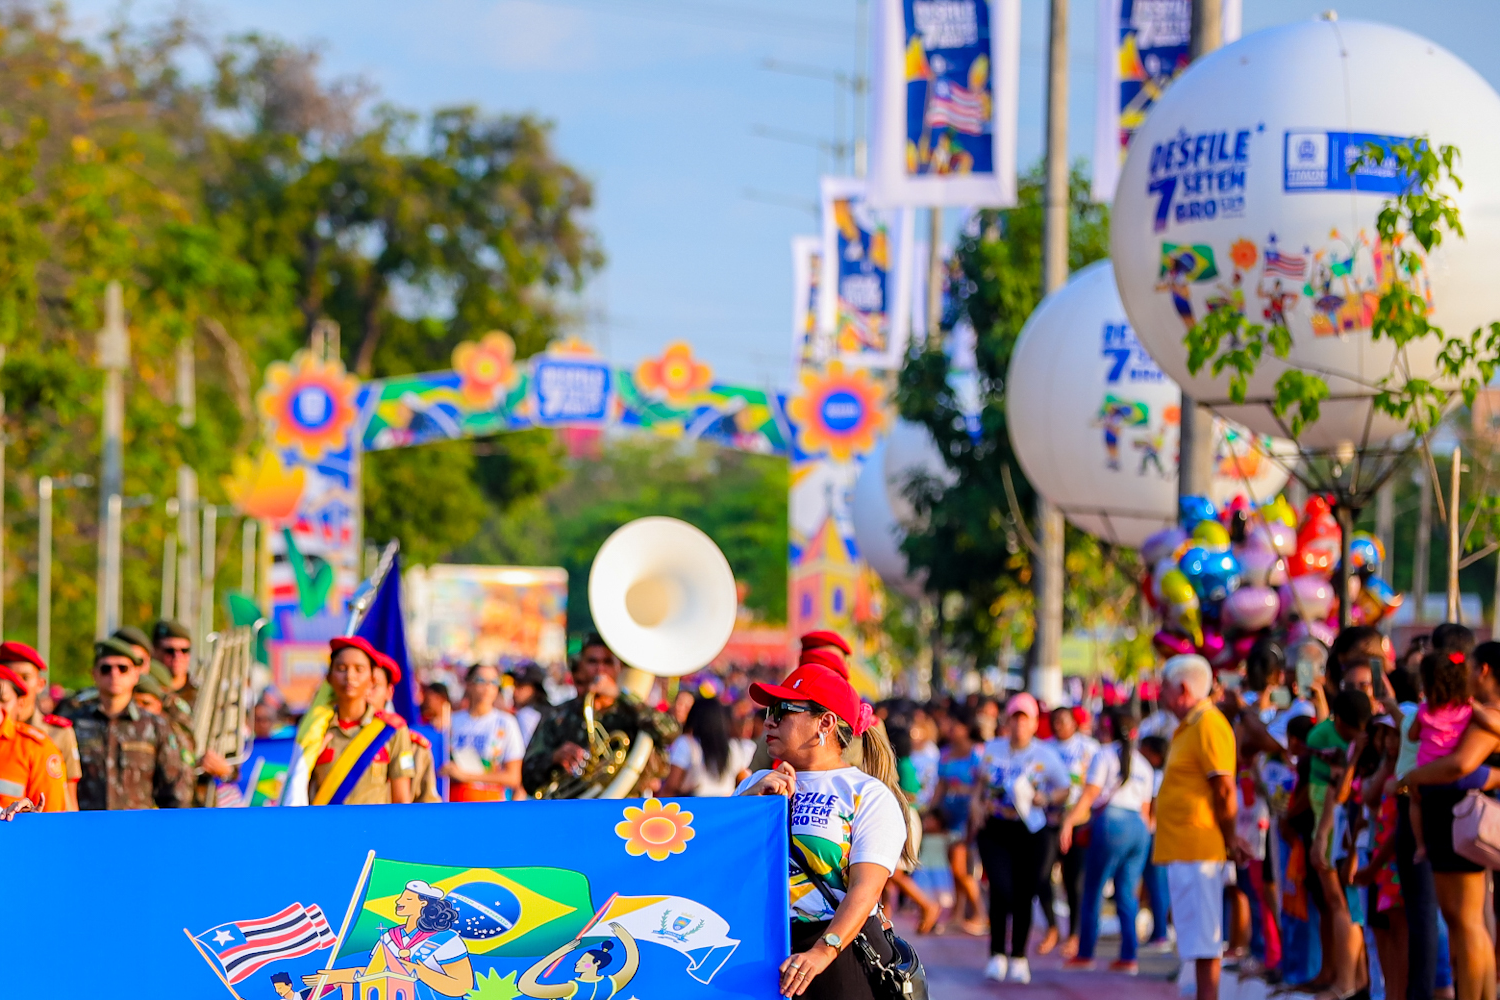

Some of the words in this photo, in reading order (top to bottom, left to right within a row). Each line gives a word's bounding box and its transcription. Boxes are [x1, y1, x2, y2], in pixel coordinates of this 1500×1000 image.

[1150, 131, 1250, 175] DESFILE
[1148, 176, 1178, 233] 7
[1103, 348, 1131, 383] 7
